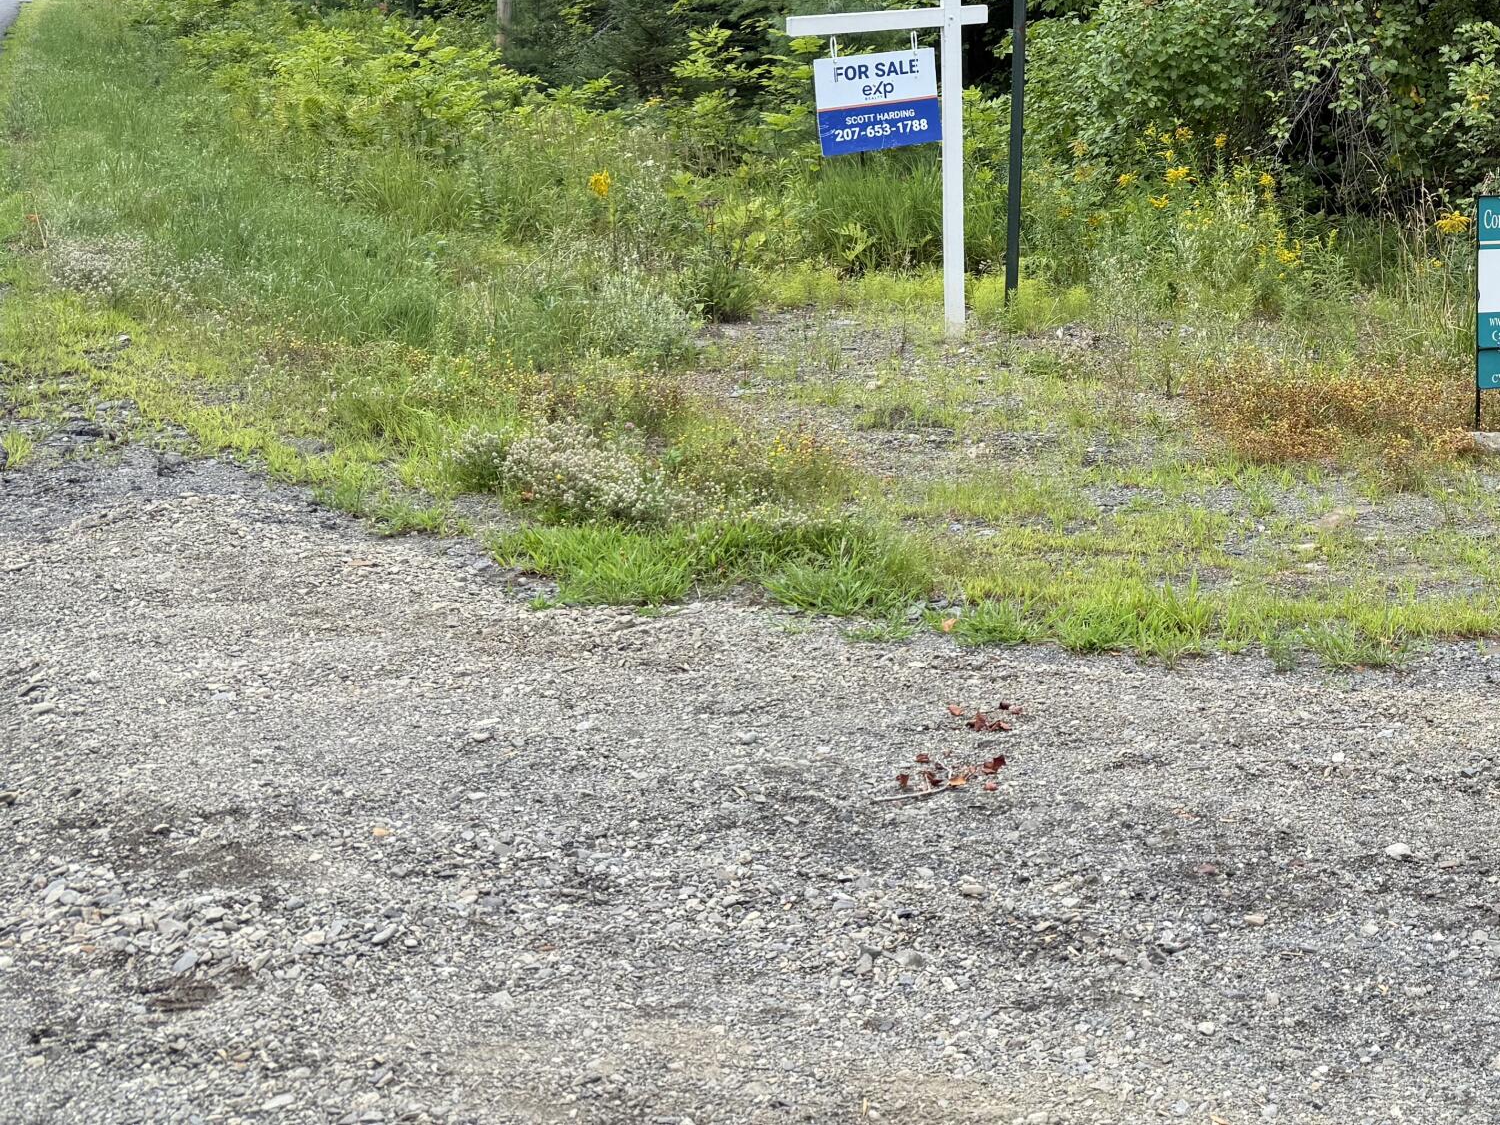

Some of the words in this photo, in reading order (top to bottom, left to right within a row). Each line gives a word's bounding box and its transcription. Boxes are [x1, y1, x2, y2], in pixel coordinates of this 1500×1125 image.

[833, 64, 870, 82] FOR
[875, 59, 920, 78] SALE
[845, 113, 875, 125] SCOTT
[876, 109, 916, 121] HARDING
[834, 118, 929, 142] 207-653-1788
